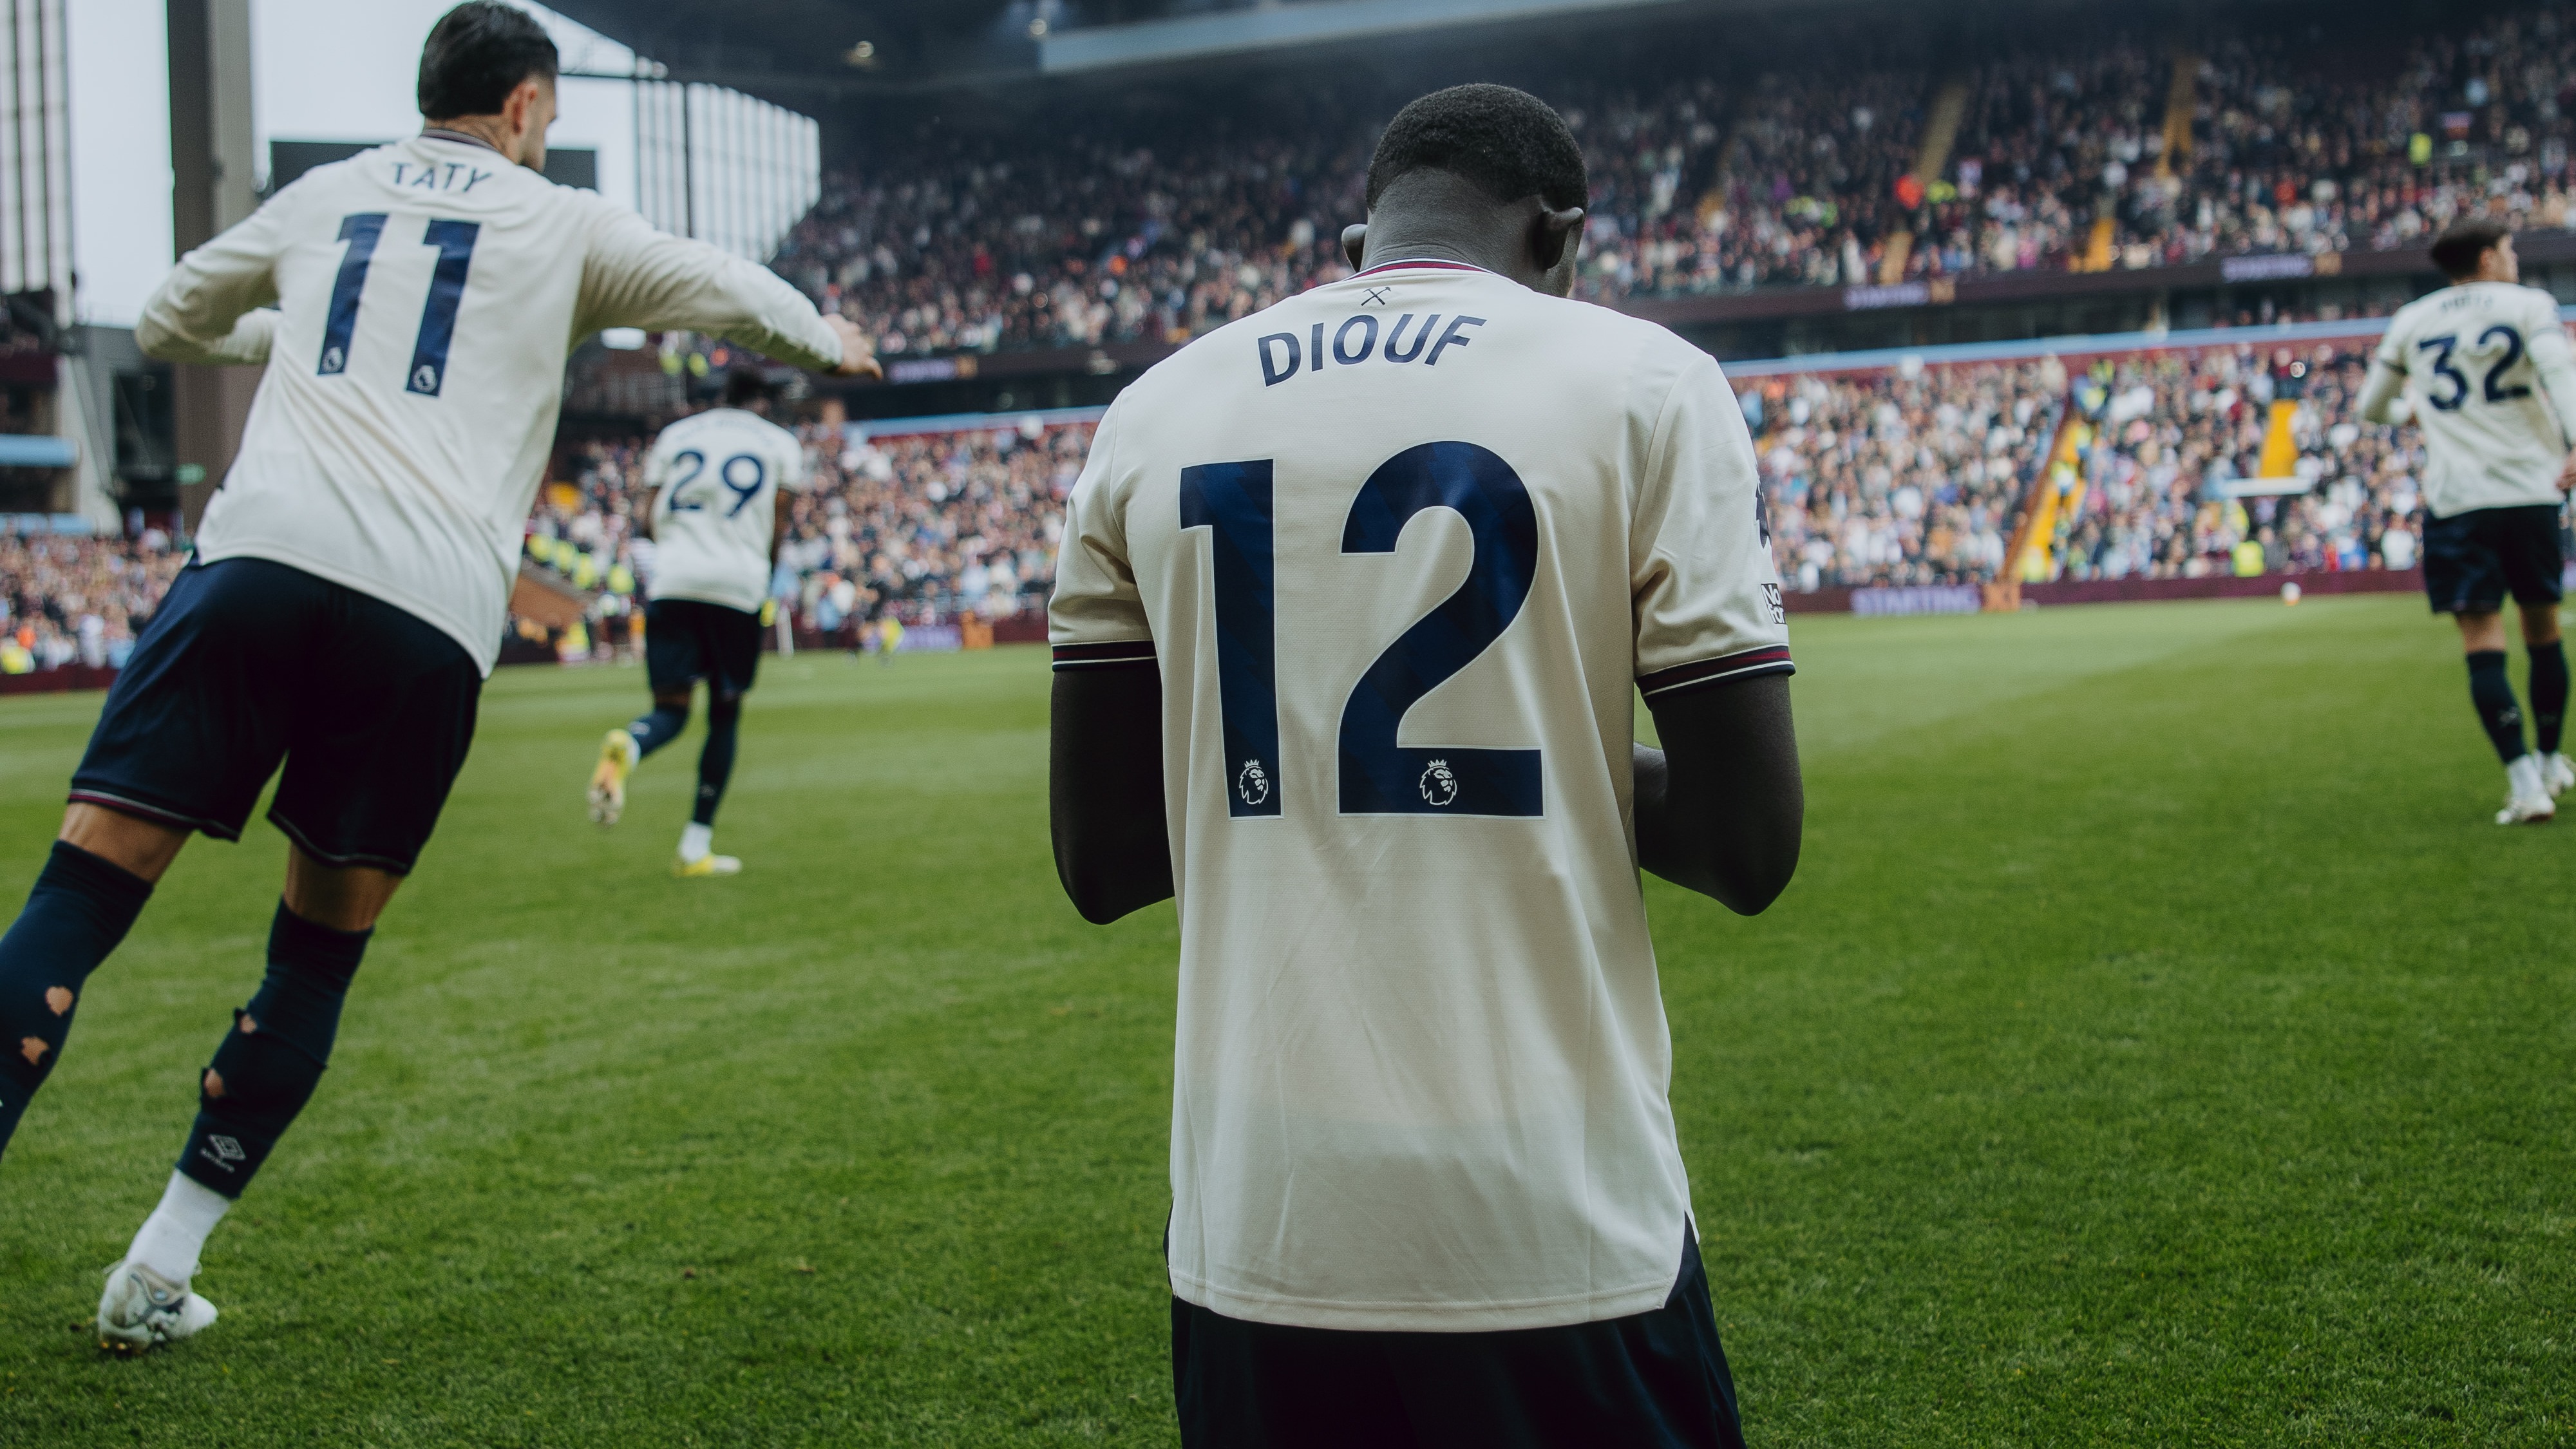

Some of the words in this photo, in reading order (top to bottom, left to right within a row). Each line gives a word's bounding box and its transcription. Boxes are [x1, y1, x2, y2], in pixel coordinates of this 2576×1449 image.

[392, 162, 493, 193] TATY
[316, 211, 482, 397] 11
[1257, 313, 1488, 388] DIOUF
[2419, 326, 2531, 411] 32
[668, 450, 764, 519] 29
[1179, 439, 1545, 818] 12
[1761, 584, 1782, 605] No
